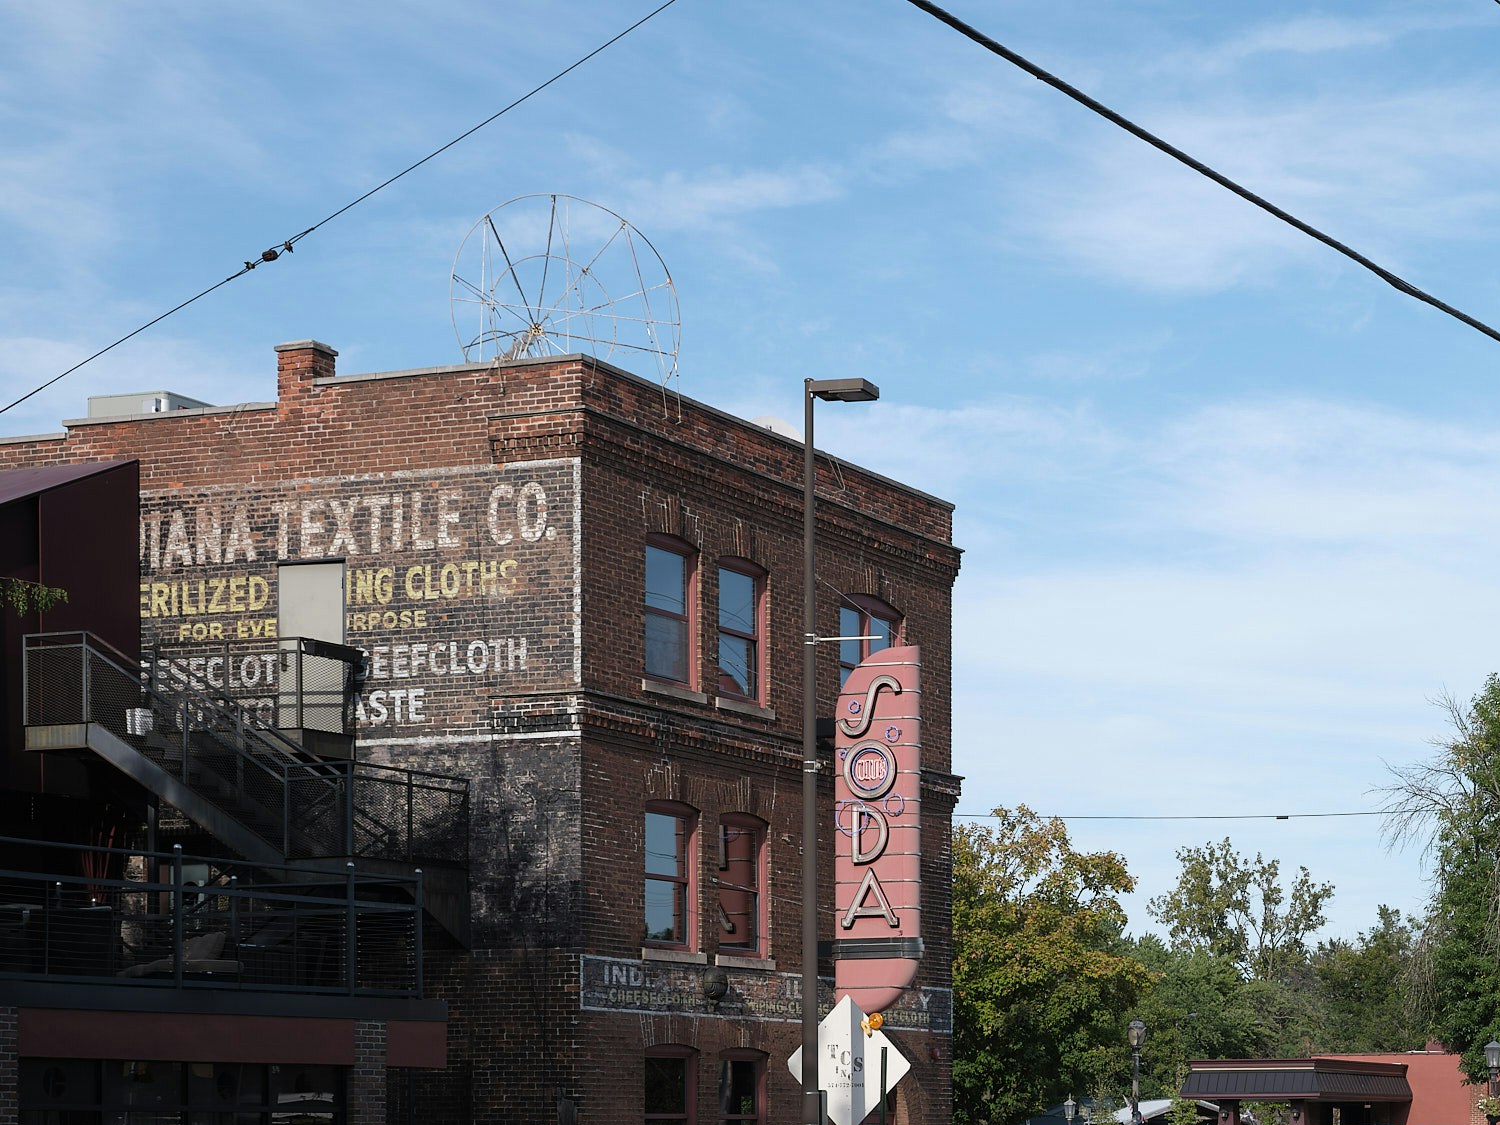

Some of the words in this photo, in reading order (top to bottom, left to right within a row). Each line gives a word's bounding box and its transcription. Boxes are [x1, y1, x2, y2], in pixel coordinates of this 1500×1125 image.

[271, 489, 462, 560] TEXTILE
[487, 481, 558, 546] CO.
[405, 559, 519, 601] CLOTHS
[178, 622, 225, 642] FOR
[838, 675, 902, 930] SODA
[826, 1044, 864, 1073] TCS
